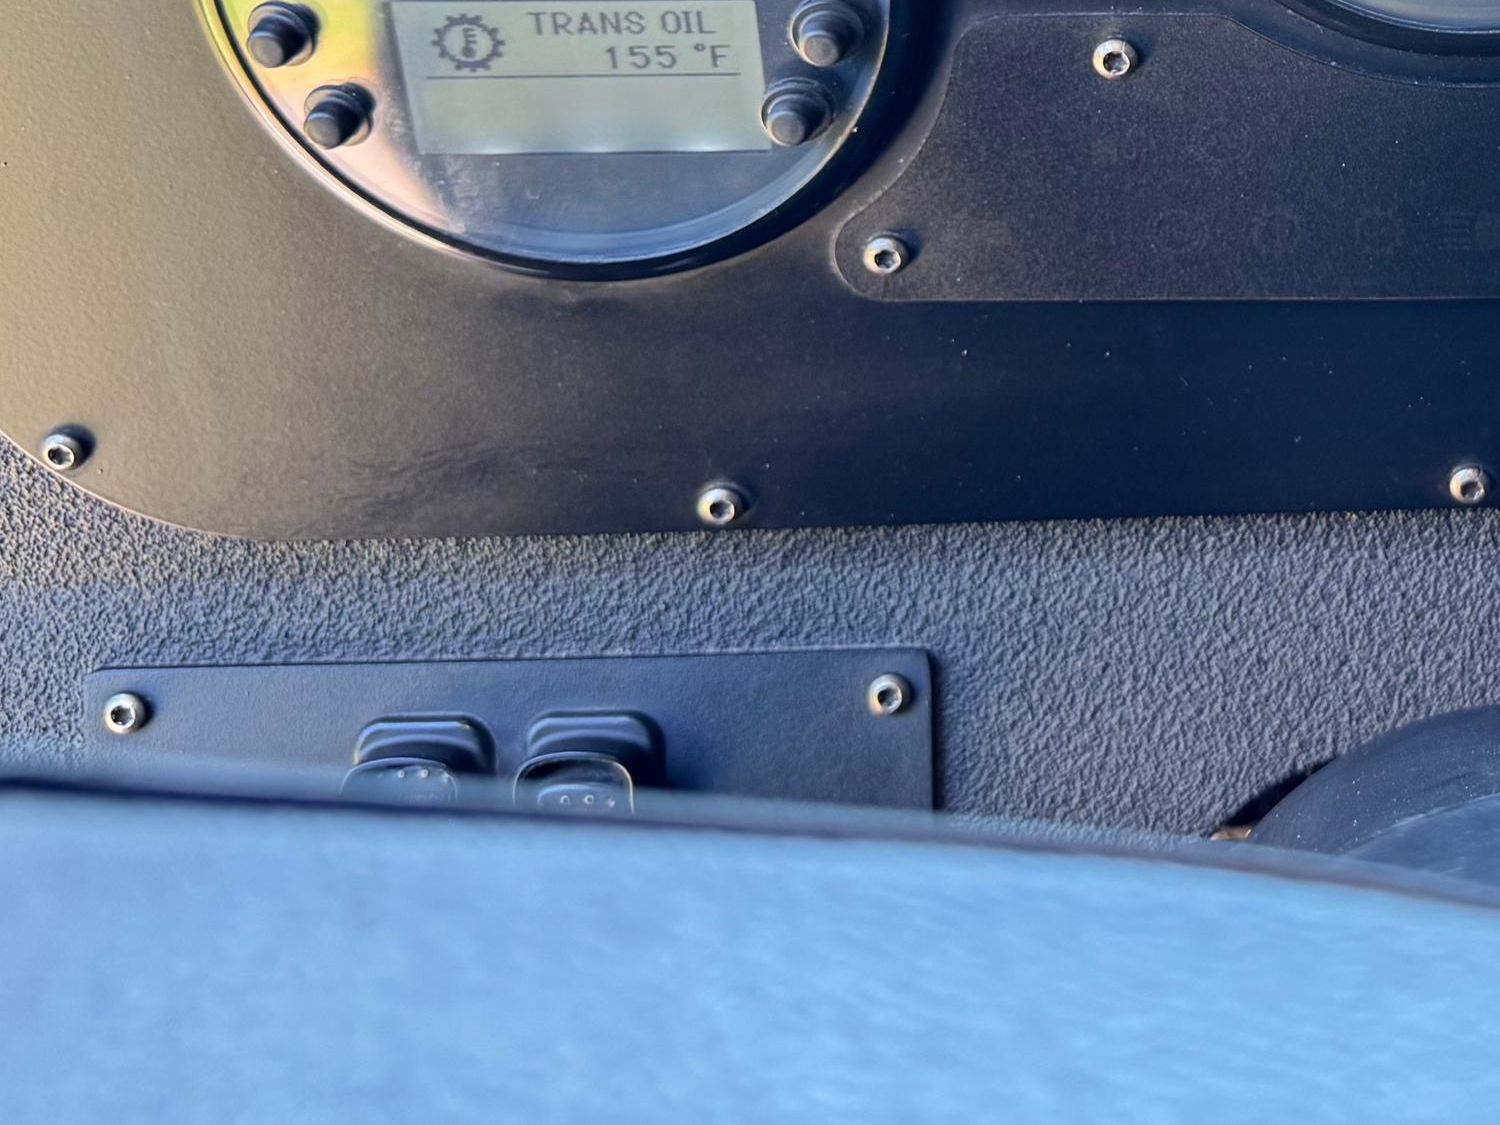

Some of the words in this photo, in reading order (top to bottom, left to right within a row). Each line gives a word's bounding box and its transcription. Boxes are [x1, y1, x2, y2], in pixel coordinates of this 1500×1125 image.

[527, 11, 645, 35] TRANS
[660, 10, 717, 34] OIL
[605, 45, 677, 69] 155
